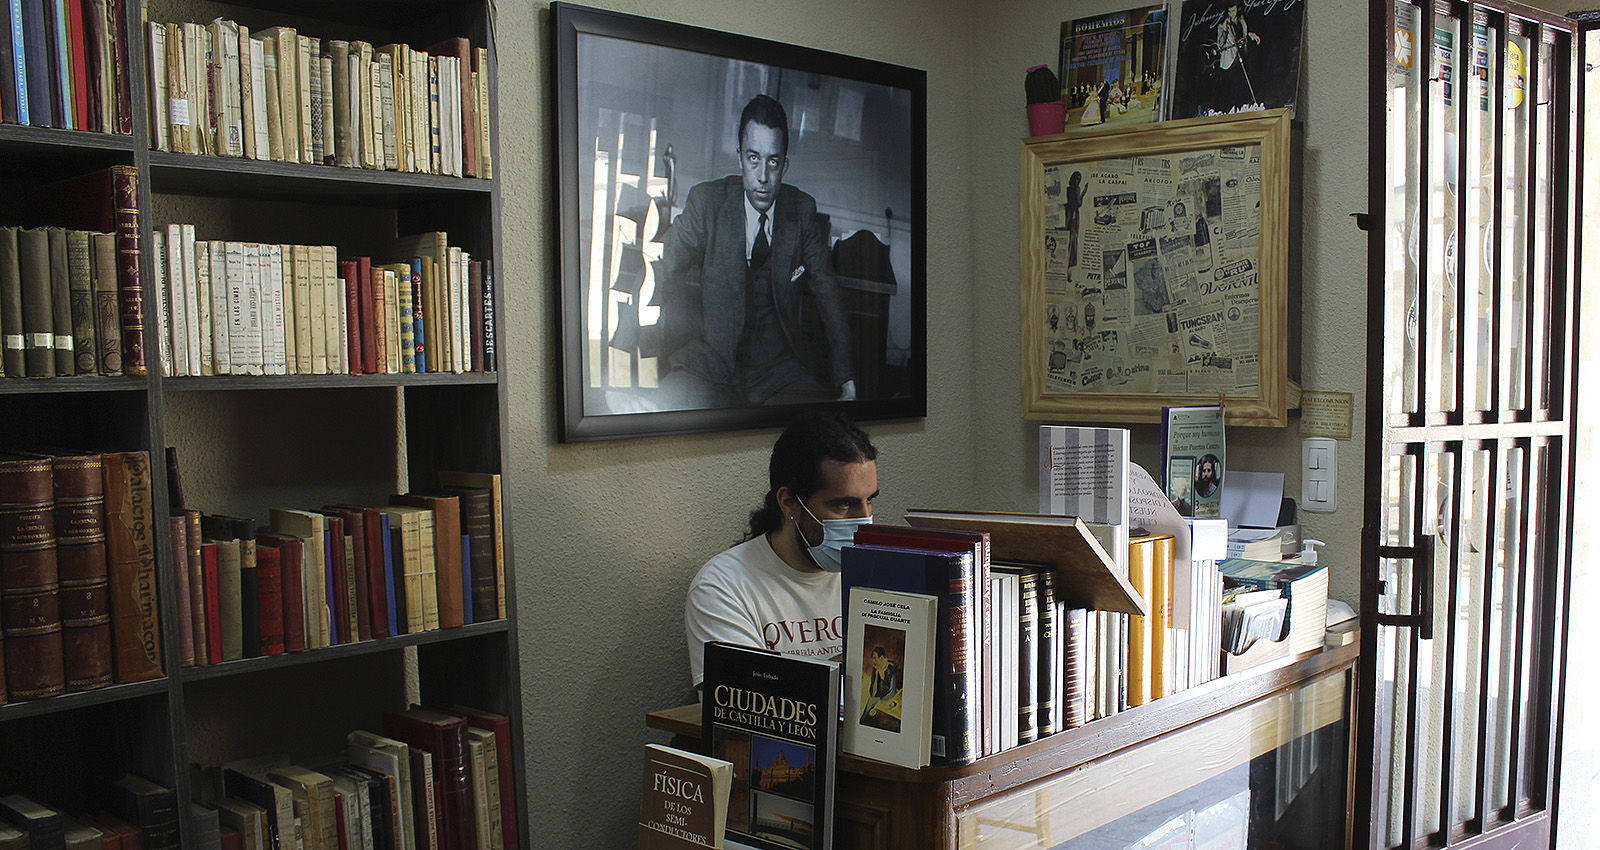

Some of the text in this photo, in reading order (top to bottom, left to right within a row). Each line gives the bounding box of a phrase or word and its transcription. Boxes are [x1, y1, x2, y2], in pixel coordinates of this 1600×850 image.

[1074, 16, 1126, 32] BOHEMIOS
[1182, 3, 1225, 42] Johnny
[1441, 50, 1451, 60] VISA
[232, 286, 240, 304] CIMAS
[234, 318, 241, 326] EN
[483, 292, 494, 354] DESCARTES
[1180, 311, 1224, 331] TUNGSRAM
[1173, 431, 1192, 440] Porque
[1195, 500, 1200, 511] 3
[983, 540, 991, 599] Armaduras
[32, 598, 40, 607] 2
[86, 592, 92, 600] 3
[863, 598, 883, 607] CAMILO
[896, 602, 911, 611] CELA
[867, 612, 889, 621] PASCUAL
[889, 616, 911, 624] DUARTE
[877, 610, 902, 618] FAMIGLIA
[763, 615, 842, 651] QVERC
[983, 611, 991, 646] Armas
[1025, 634, 1030, 642] A
[714, 684, 817, 728] CIUDADES
[714, 706, 817, 740] DE CASTILLA Y LEÓN
[653, 770, 705, 804] FÍSICA
[664, 800, 692, 816] DE LOS
[665, 812, 688, 827] SEMI-
[647, 820, 707, 845] CONDUCTORES
